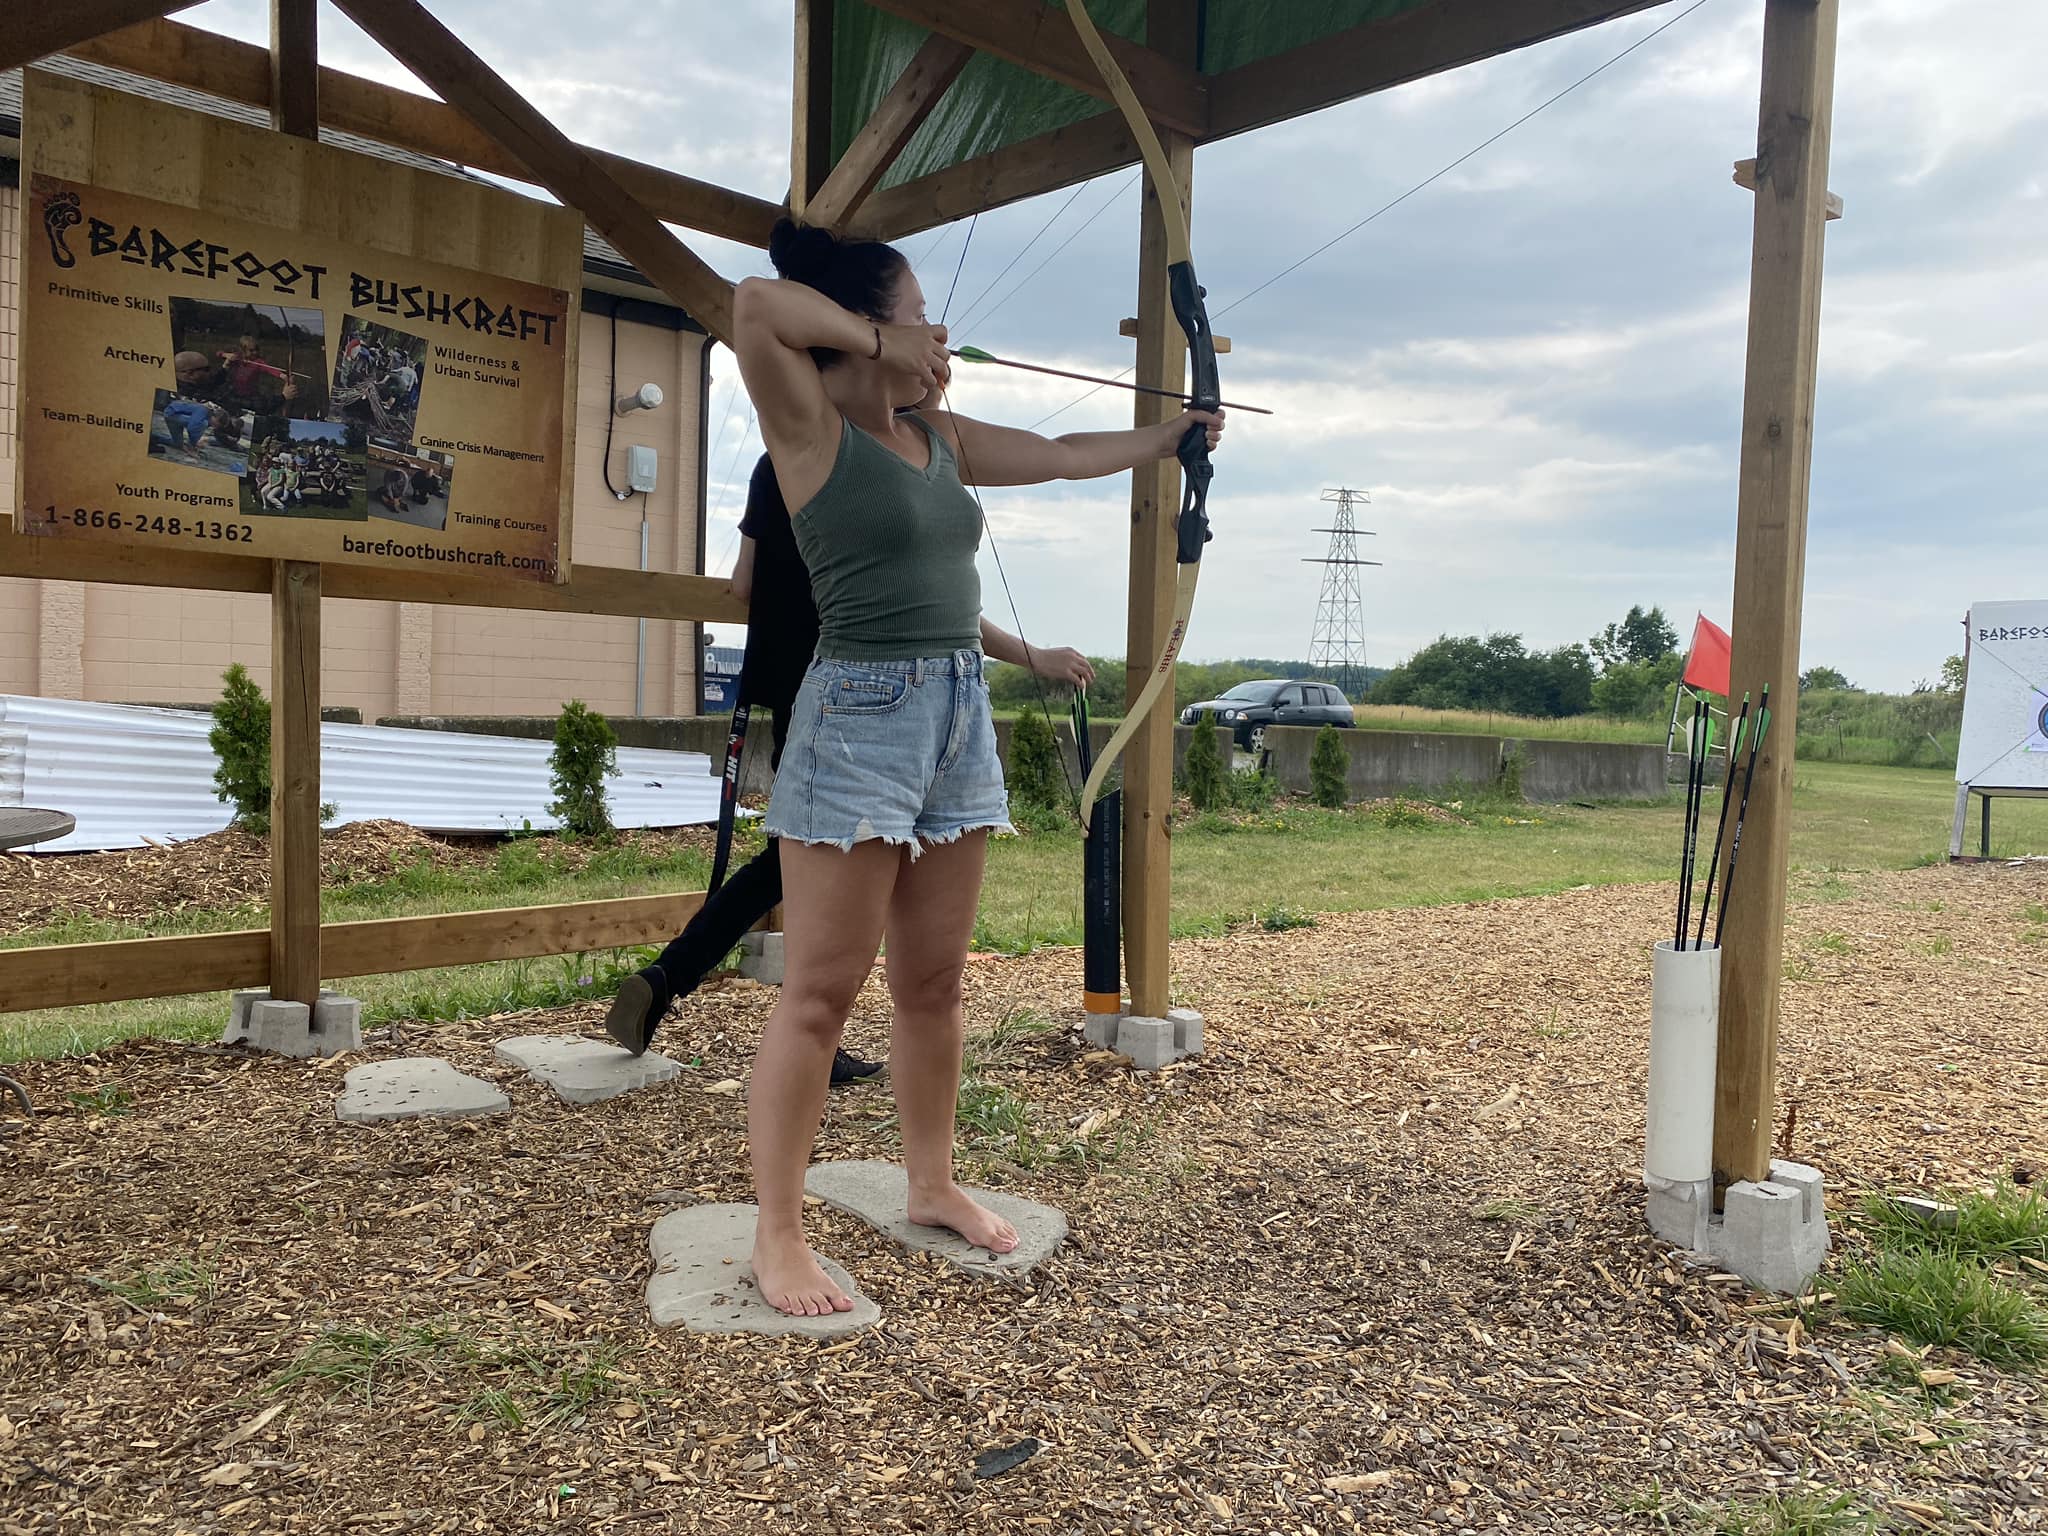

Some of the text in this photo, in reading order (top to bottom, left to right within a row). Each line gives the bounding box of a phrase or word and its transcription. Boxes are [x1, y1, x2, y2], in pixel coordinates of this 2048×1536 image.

[88, 217, 557, 345] BAREFOOT BUSHCRAFT
[48, 282, 163, 314] Primitive Skills
[104, 346, 165, 368] Archery
[434, 346, 521, 371] Wilderness &
[434, 363, 520, 388] Urban Survival
[41, 408, 144, 434] Team-Building
[420, 436, 545, 463] Canine Crisis Management
[115, 483, 234, 507] Youth Programs
[45, 506, 253, 543] 1-866-248-1362
[454, 512, 548, 533] Training Courses
[343, 535, 546, 571] barefootbushcraft.com
